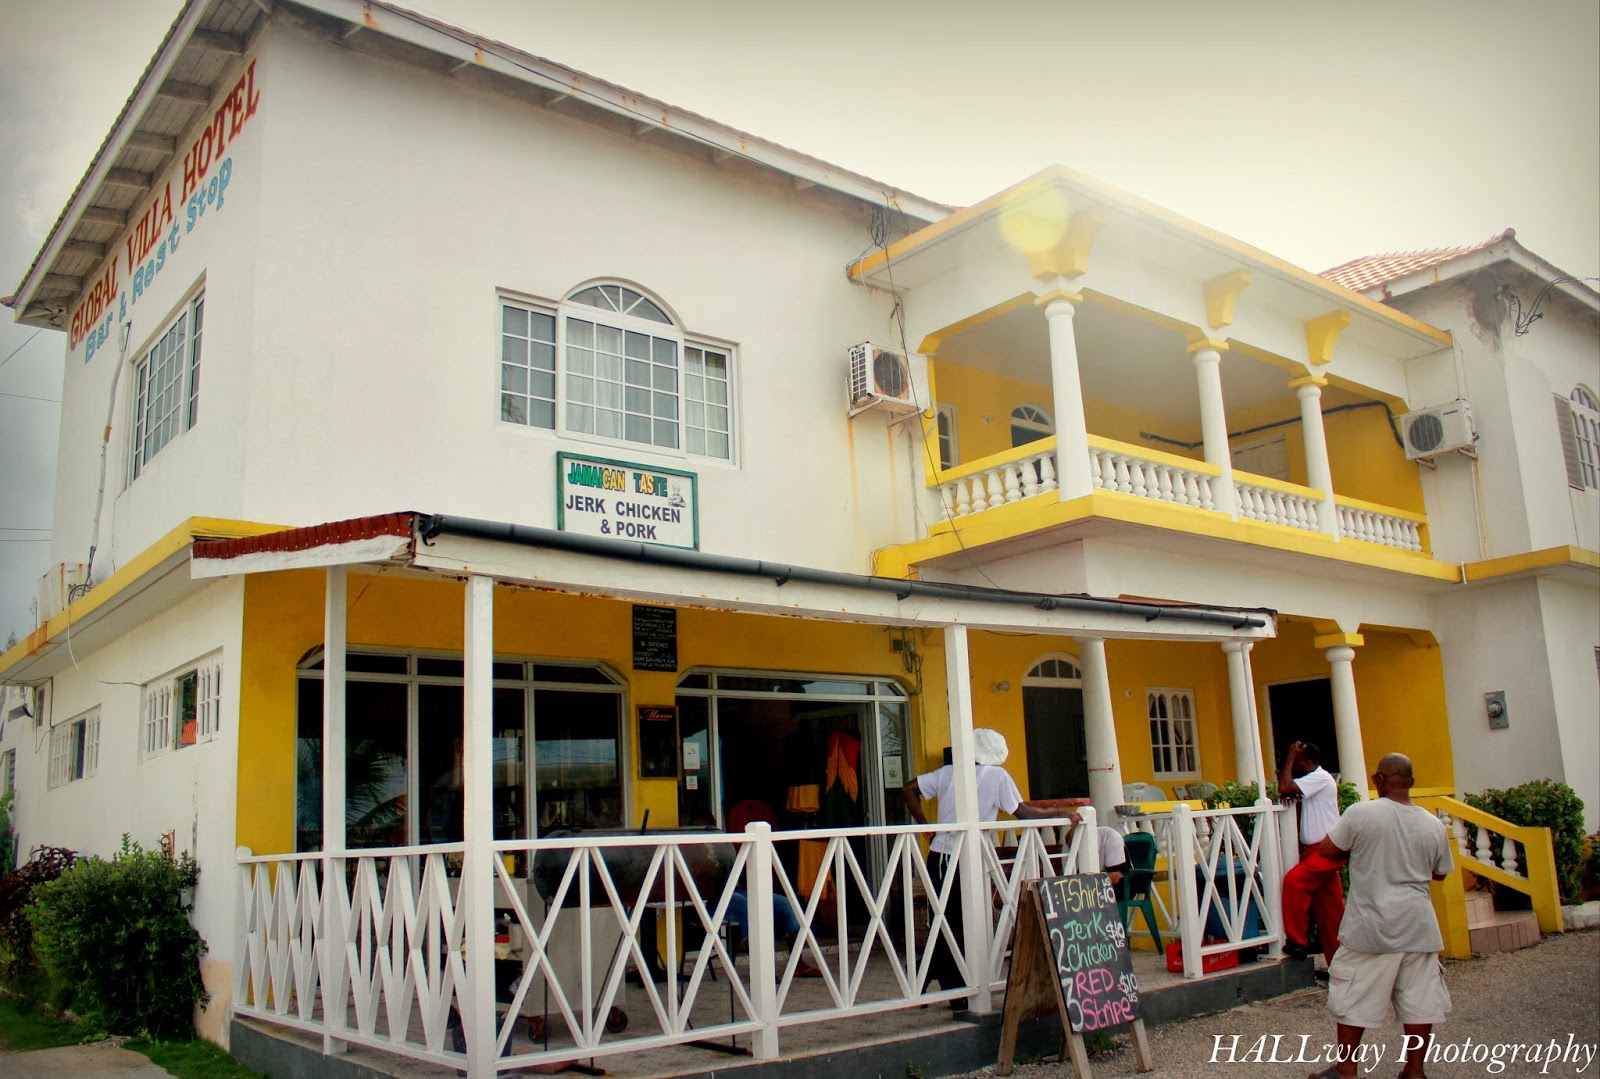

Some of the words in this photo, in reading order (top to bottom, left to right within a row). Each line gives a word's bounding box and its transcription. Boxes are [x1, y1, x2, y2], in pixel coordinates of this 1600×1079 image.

[70, 255, 119, 351] GLOBAL
[127, 181, 173, 278] VILLA
[180, 57, 261, 207] HOTEL
[85, 312, 113, 365] Bar
[119, 291, 127, 323] &
[132, 215, 180, 306] Rest
[187, 157, 232, 234] Stop
[567, 462, 626, 493] JAMAICAN
[633, 472, 668, 498] TASTE
[566, 494, 606, 514] JERK
[615, 501, 681, 524] CHICKEN
[600, 519, 611, 534] &
[616, 521, 657, 540] PORK
[640, 709, 673, 720] Menu
[1053, 878, 1104, 913] T-Shirt
[1050, 928, 1071, 974] 2
[1063, 911, 1107, 941] Jerk
[1067, 942, 1118, 972] Chicken
[1061, 977, 1084, 1032] 3
[1075, 968, 1115, 998] RED
[1081, 997, 1136, 1031] Stripe
